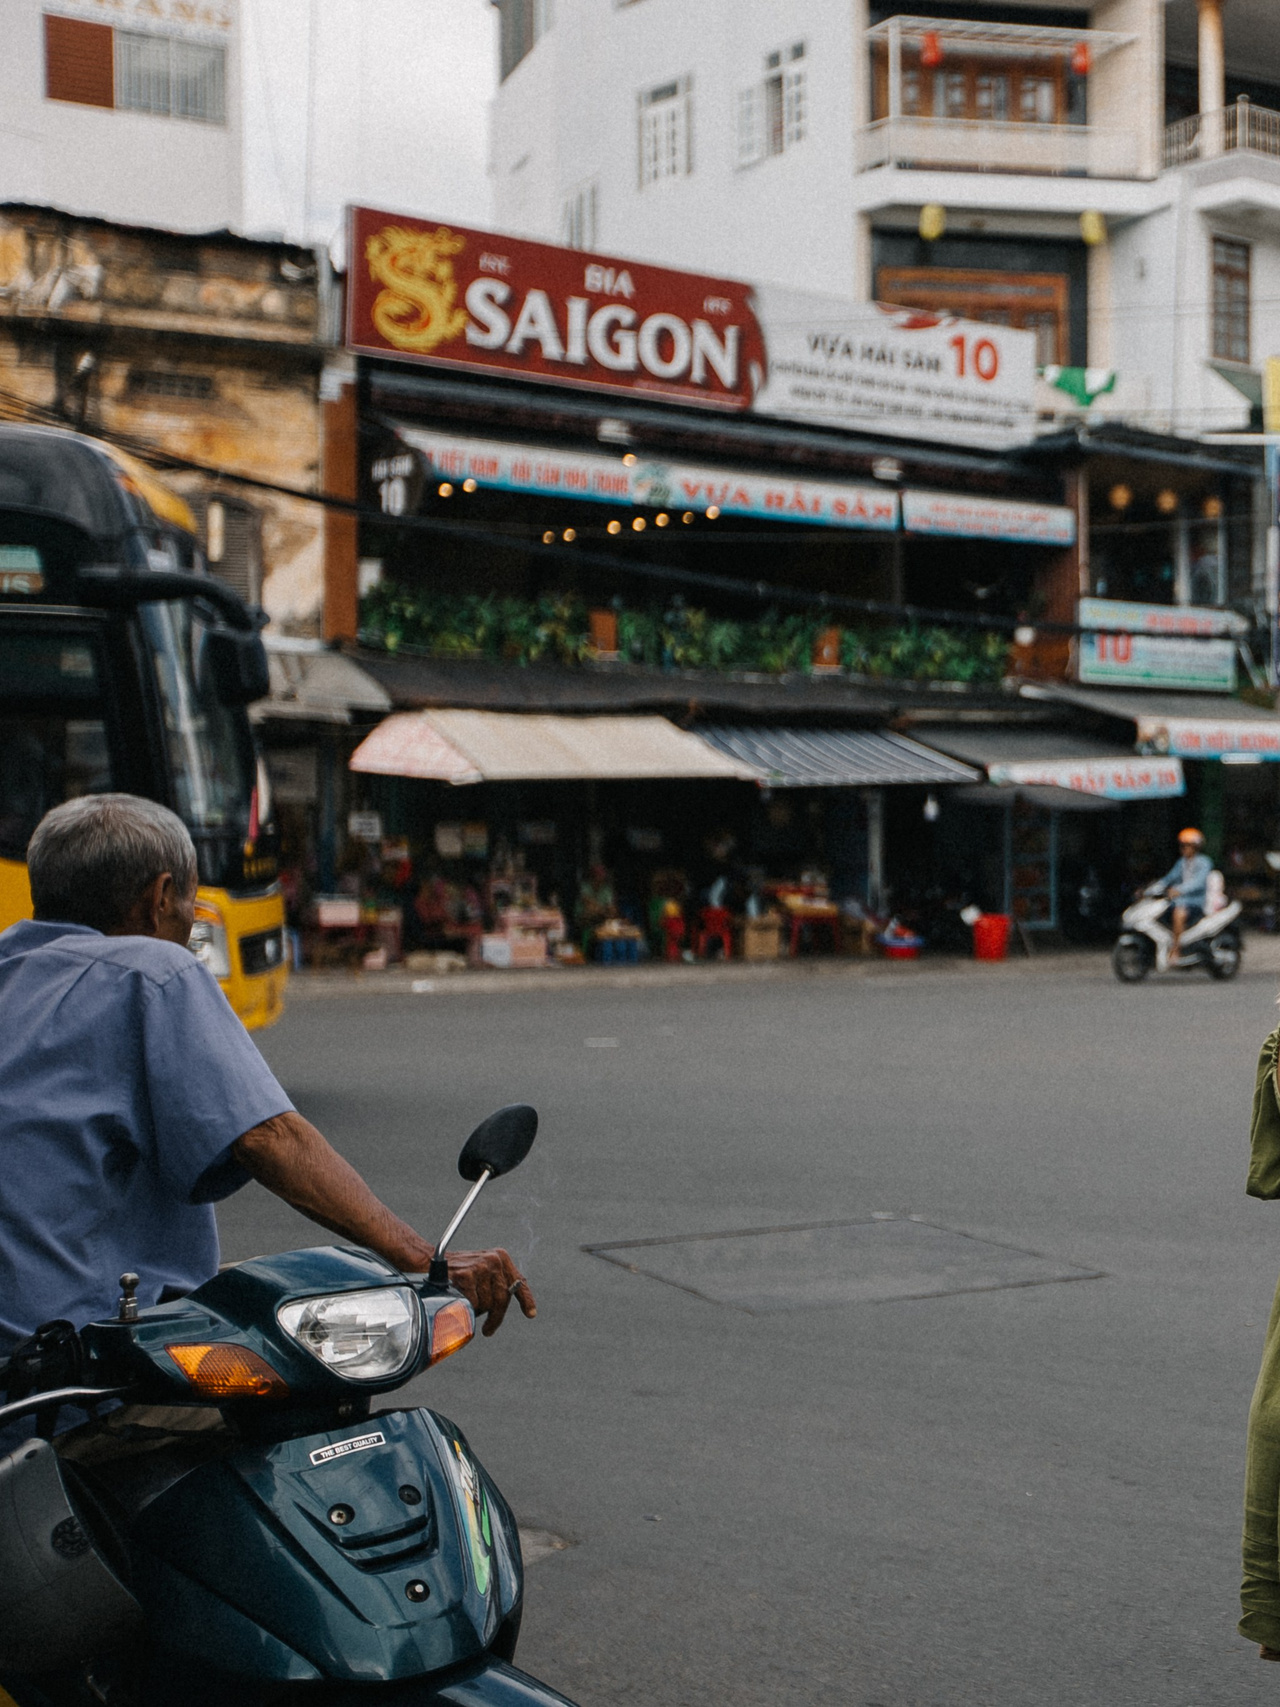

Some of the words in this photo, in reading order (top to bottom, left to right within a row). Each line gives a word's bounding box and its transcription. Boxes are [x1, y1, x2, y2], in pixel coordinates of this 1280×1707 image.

[585, 264, 636, 299] BIA
[465, 277, 741, 389] SAIGON
[949, 335, 999, 381] 10
[320, 1449, 335, 1459] THE
[335, 1443, 352, 1454] BEST
[352, 1436, 378, 1448] QUALITY
